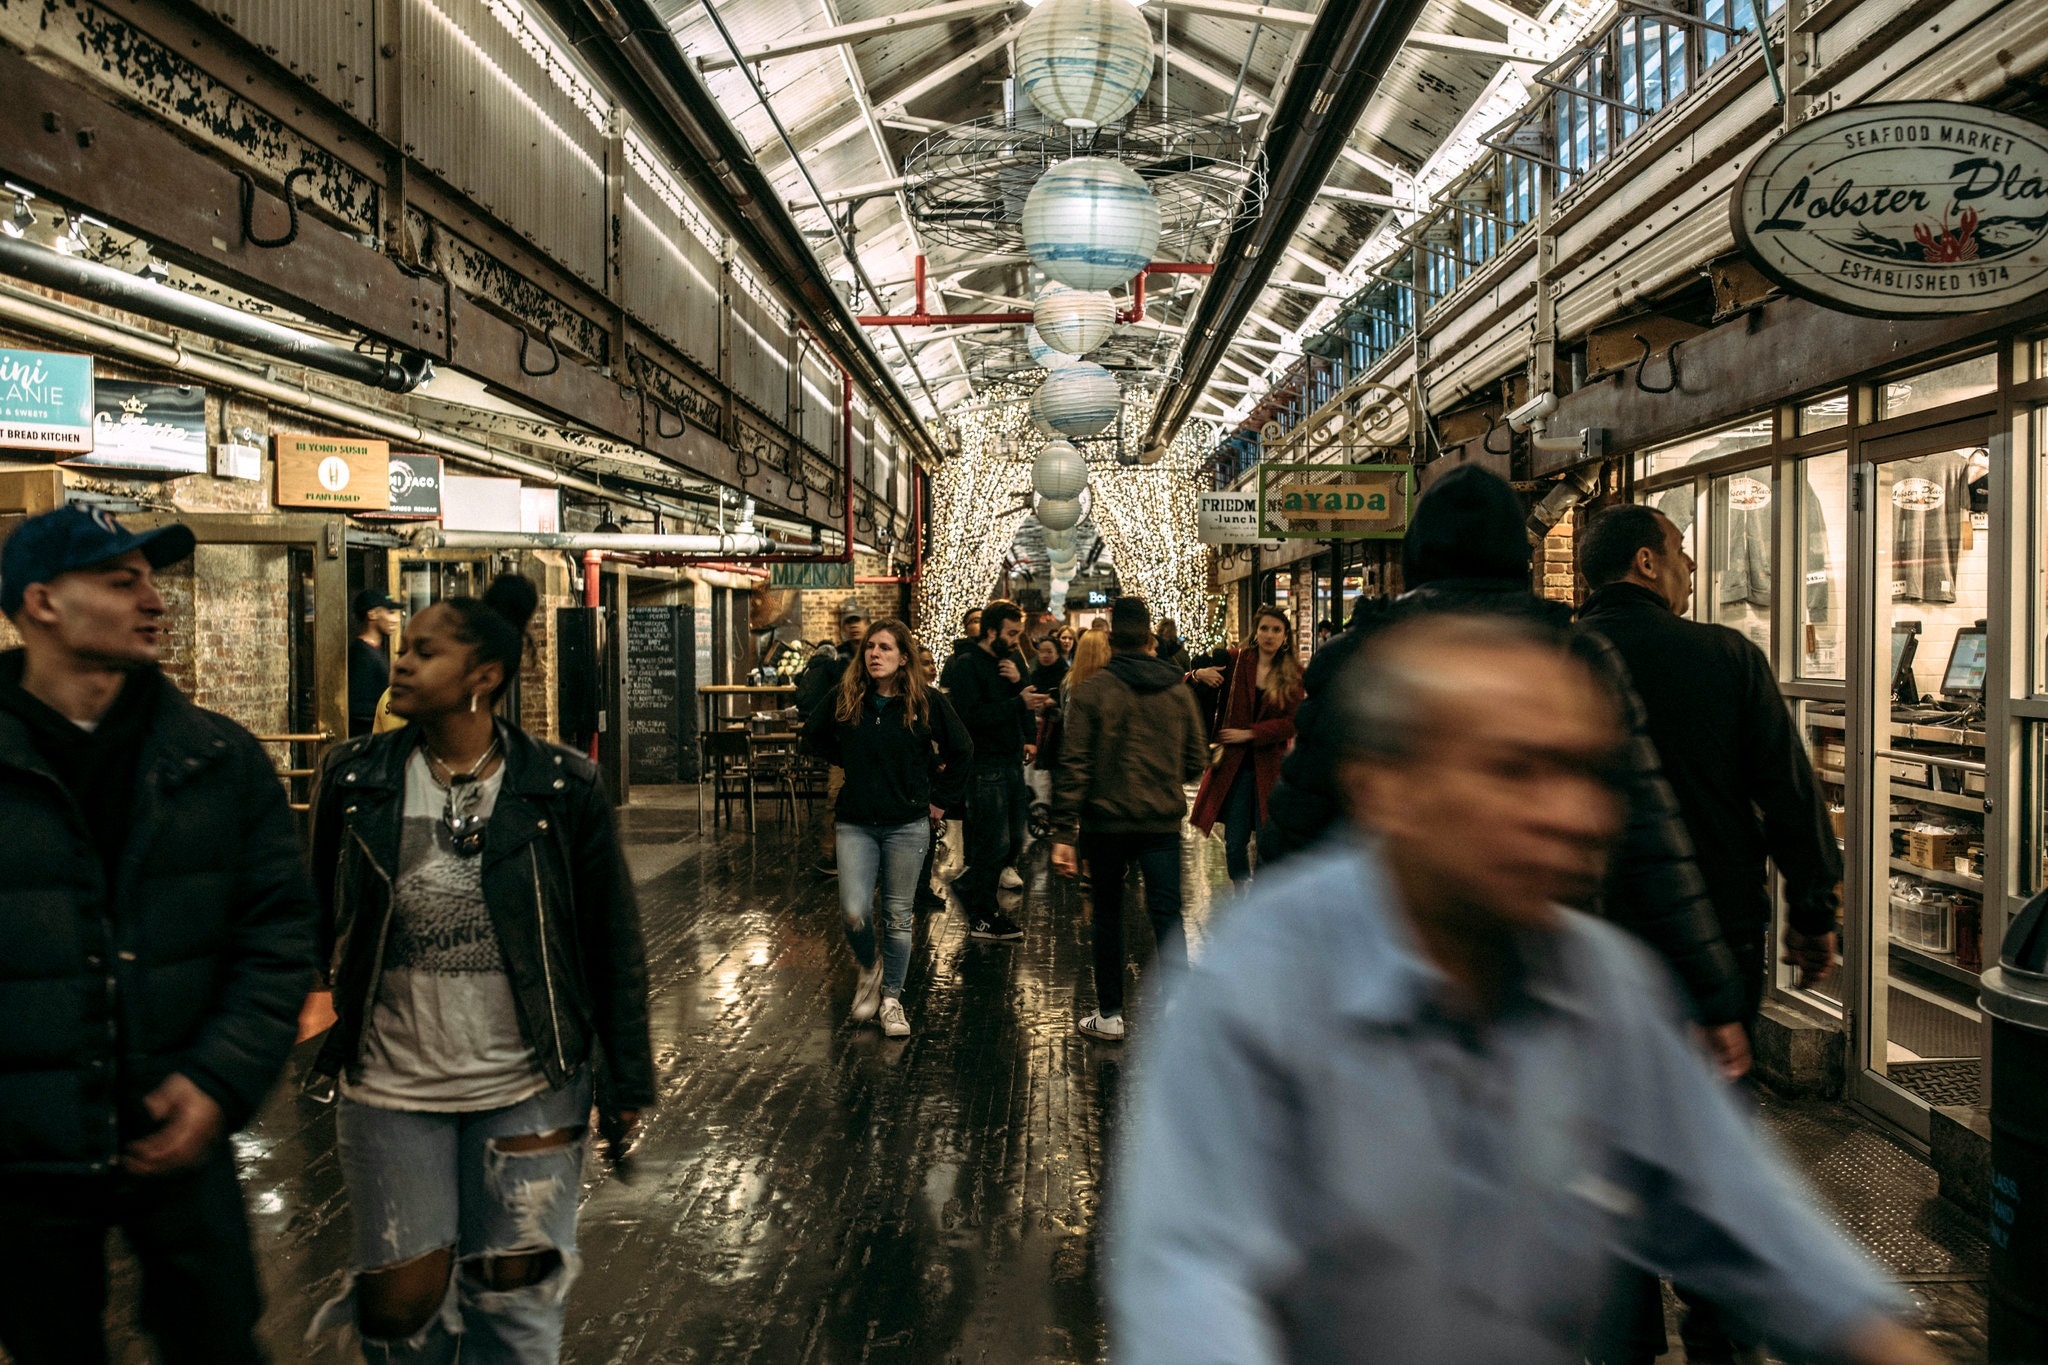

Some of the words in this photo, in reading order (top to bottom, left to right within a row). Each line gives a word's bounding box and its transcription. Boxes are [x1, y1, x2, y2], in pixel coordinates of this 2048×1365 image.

[1845, 125, 1930, 149] SEAFOOD
[1941, 127, 2016, 155] MARKET
[1754, 176, 1930, 235] Lobster
[1949, 157, 2048, 216] Pla
[1840, 260, 1960, 290] ESTABLISHED
[1968, 266, 2010, 288] 1974
[0, 356, 49, 390] ini
[0, 383, 64, 406] ANIE
[15, 408, 48, 419] SWEETS
[7, 429, 39, 440] BREAD
[40, 431, 81, 443] KITCHEN
[296, 442, 338, 454] BEYOND
[339, 445, 369, 455] SUSHI
